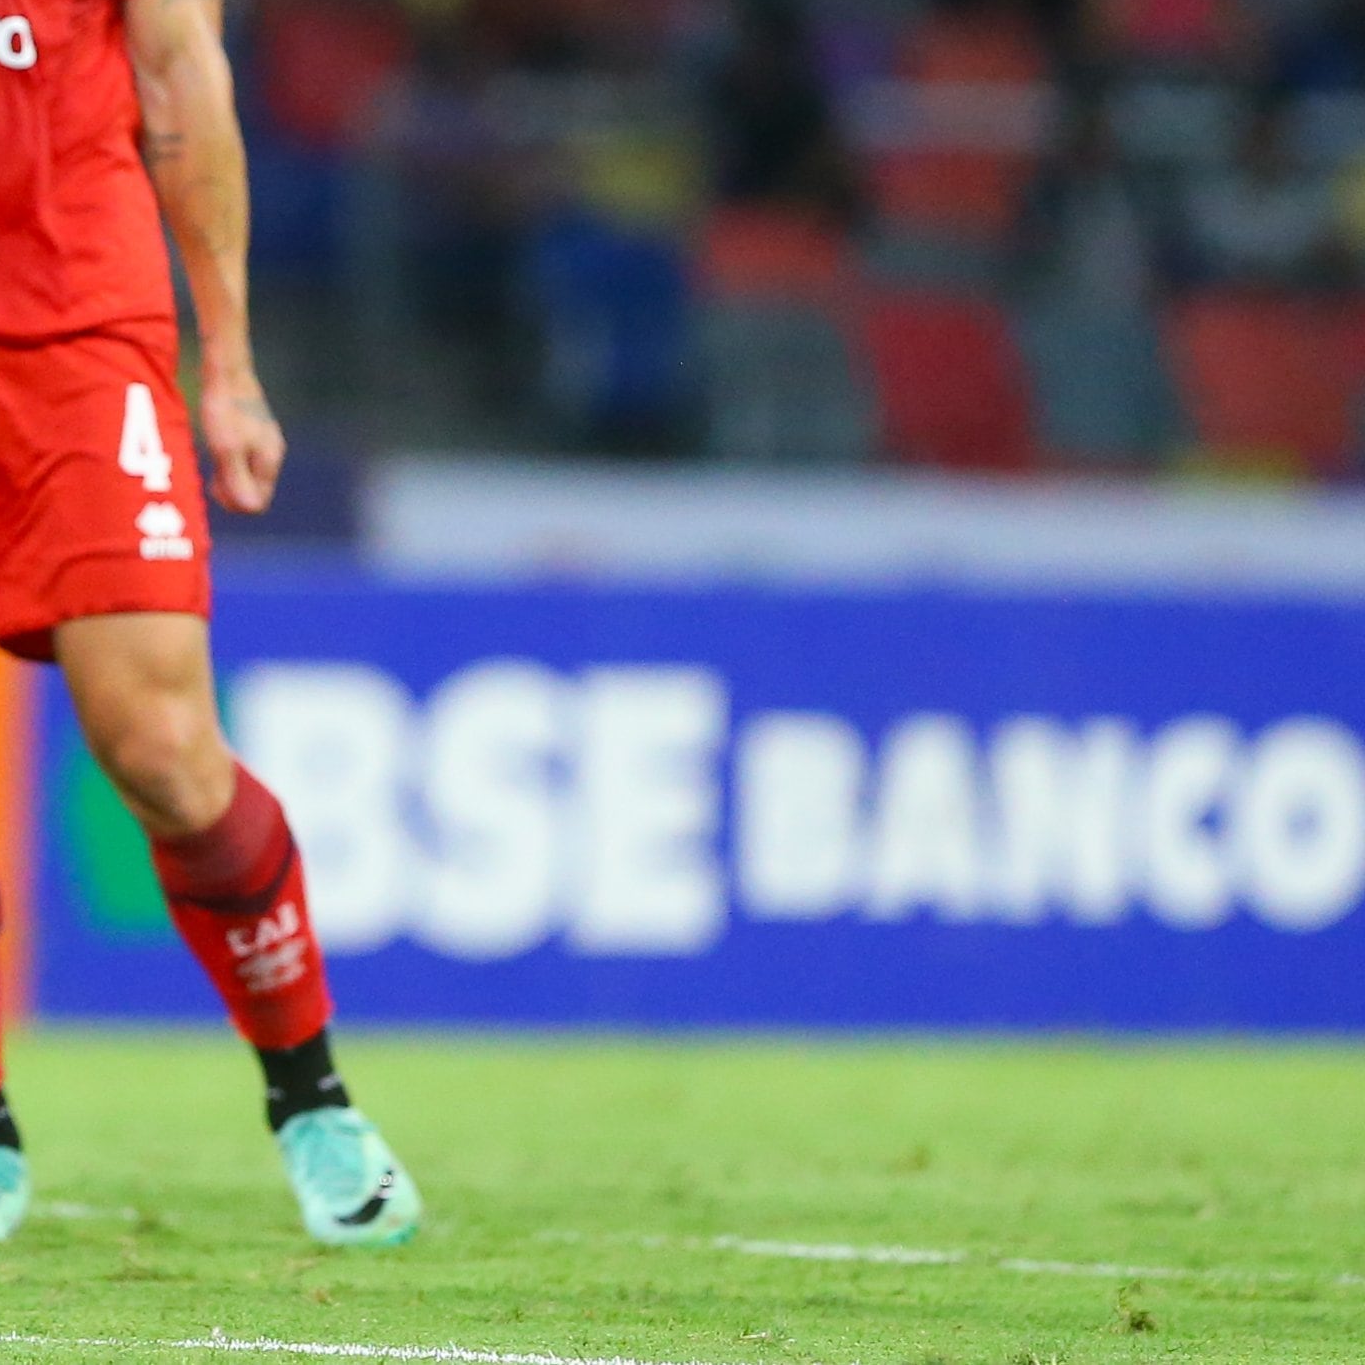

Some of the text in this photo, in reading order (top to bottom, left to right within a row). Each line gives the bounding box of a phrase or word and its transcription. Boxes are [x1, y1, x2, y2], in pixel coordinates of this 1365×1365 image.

[118, 381, 174, 494] 4
[234, 660, 1363, 959] BSE BANCO
